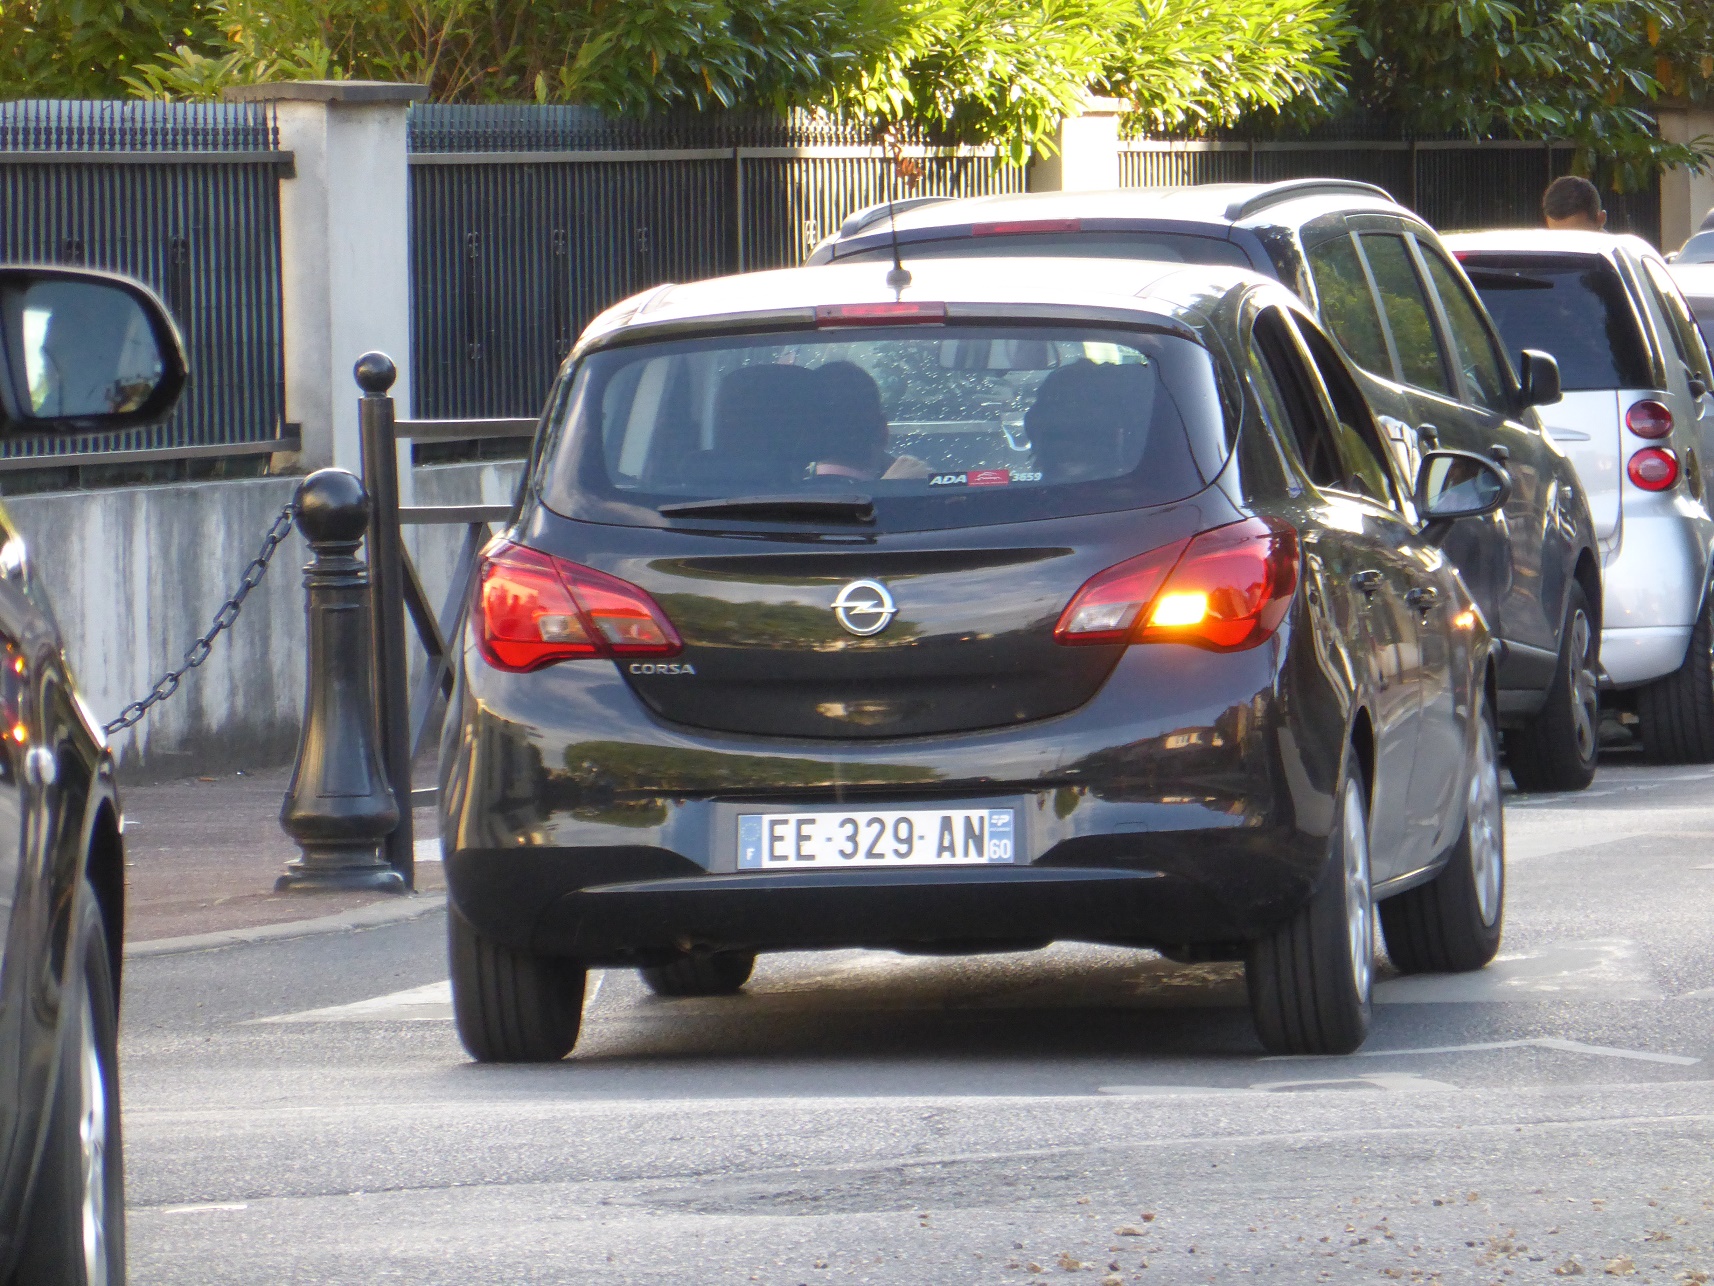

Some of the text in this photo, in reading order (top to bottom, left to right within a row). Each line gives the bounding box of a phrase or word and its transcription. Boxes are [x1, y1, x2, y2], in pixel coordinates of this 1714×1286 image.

[929, 474, 967, 486] ADA
[629, 663, 696, 675] CORSA
[768, 815, 985, 862] EE-329-AN
[746, 847, 756, 861] F
[989, 839, 1011, 859] 60
